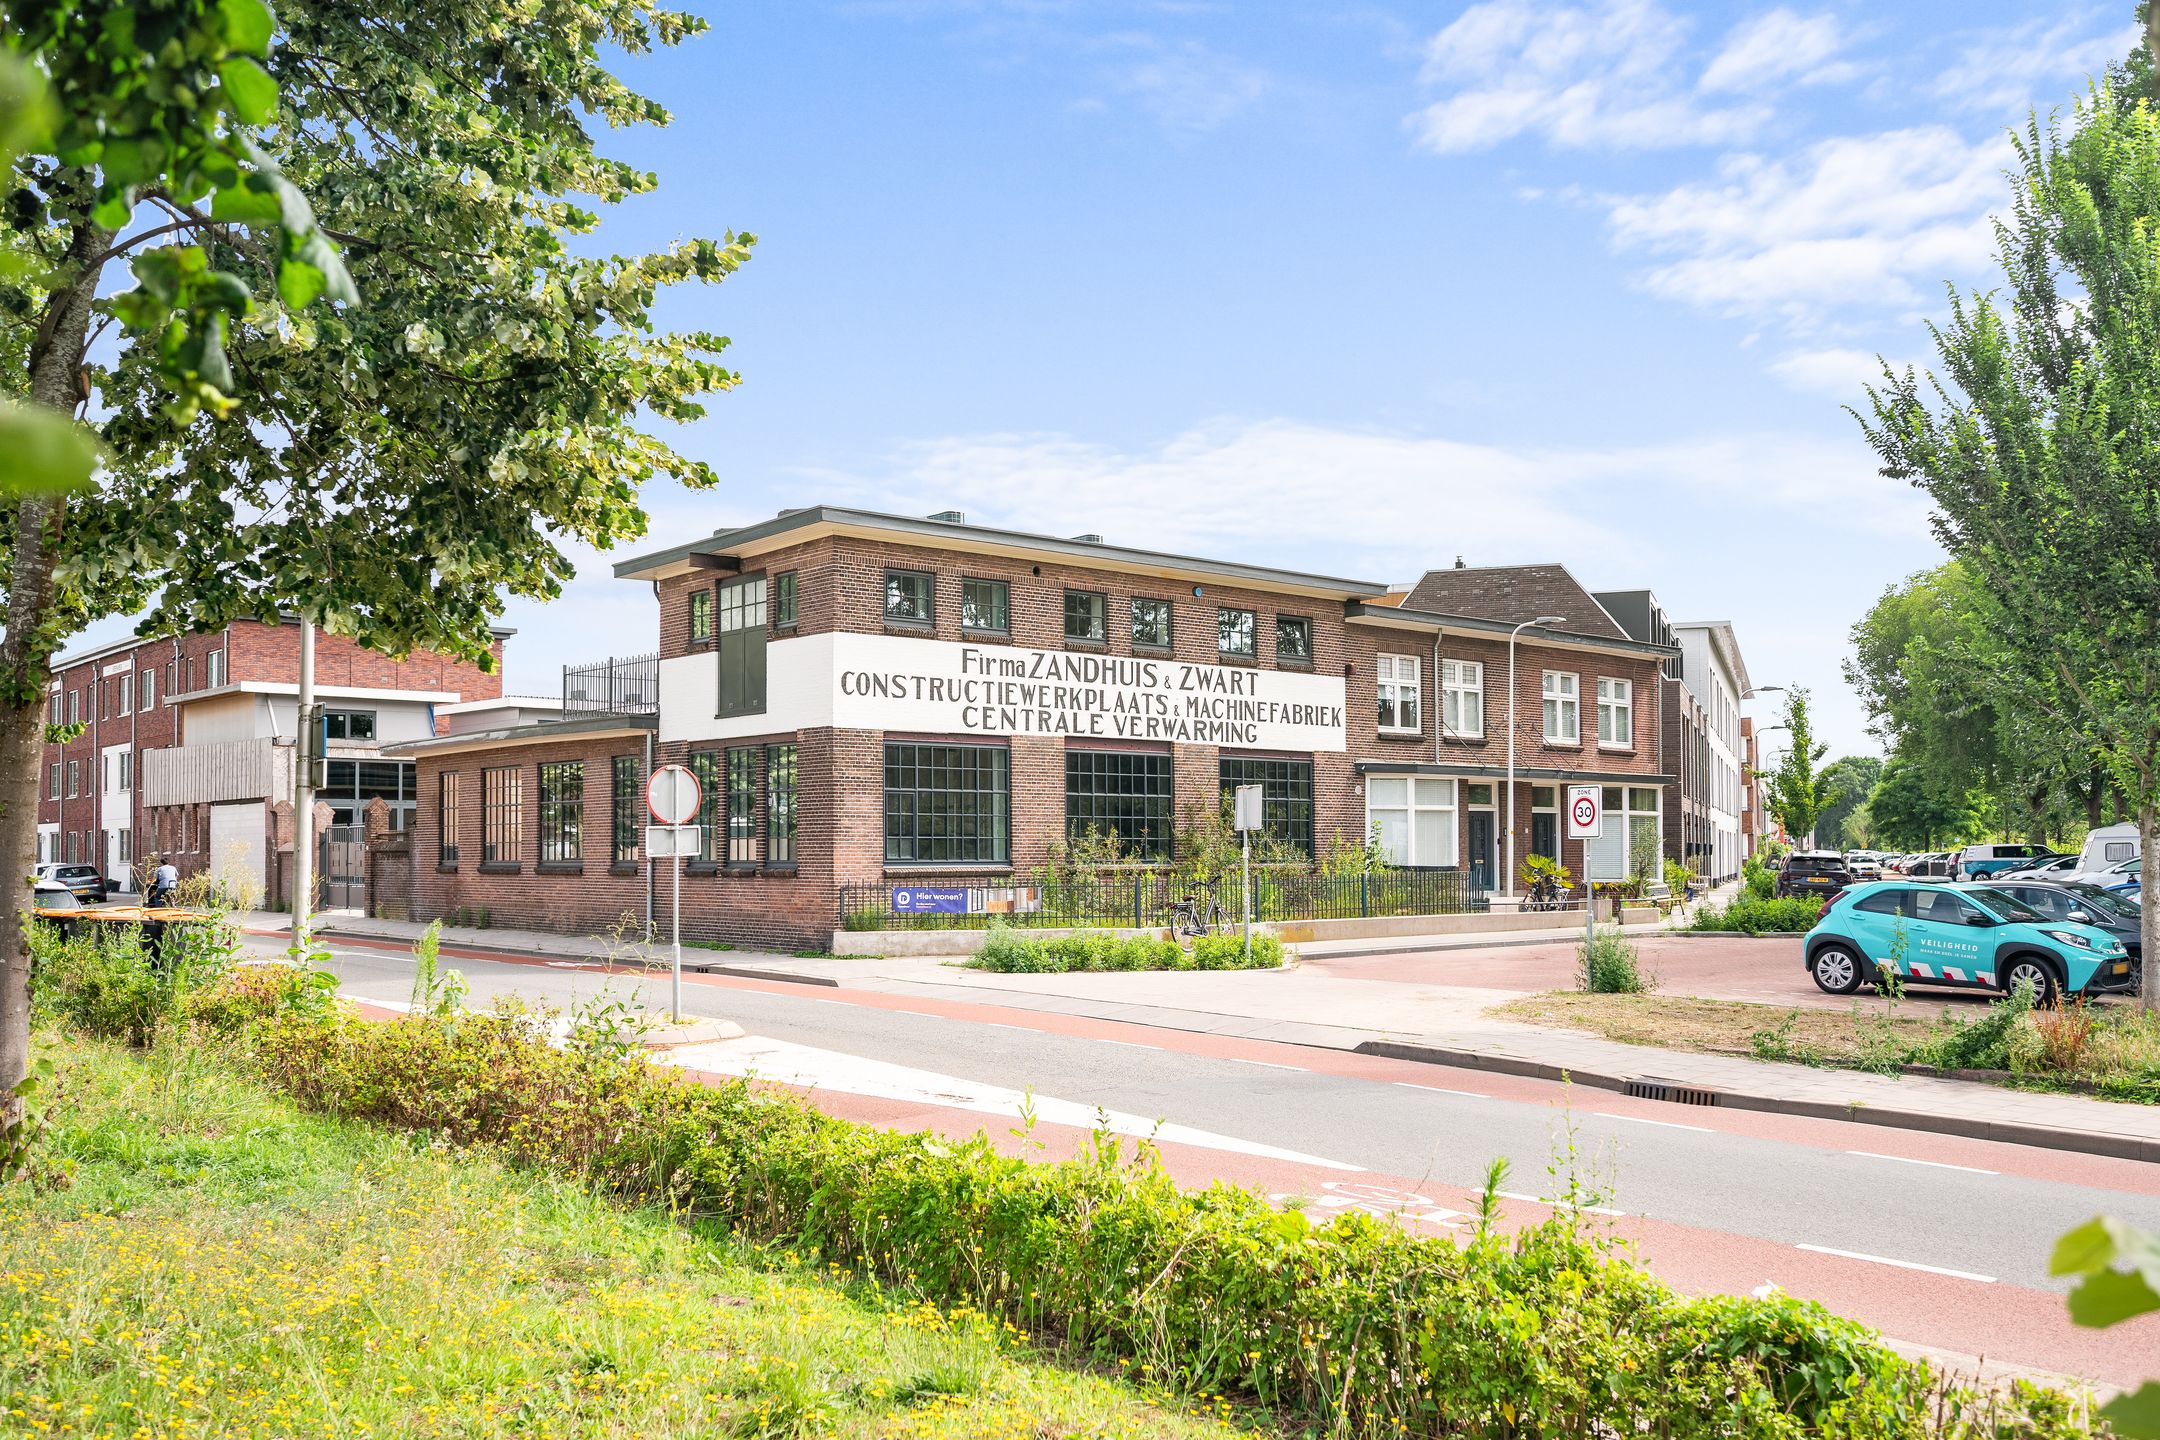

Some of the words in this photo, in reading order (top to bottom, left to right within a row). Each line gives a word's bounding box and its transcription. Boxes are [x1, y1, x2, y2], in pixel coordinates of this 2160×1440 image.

[962, 648, 1025, 678] Firma
[1028, 652, 1158, 688] ZANDHUIS
[1163, 675, 1173, 690] &
[1178, 665, 1259, 696] ZWART
[840, 671, 1168, 716] CONSTRUCTIEWERKPLAATS
[1173, 704, 1181, 717] &
[1186, 696, 1342, 728] MACHINEFABRIEK
[962, 706, 1104, 735] CENTRALE
[1113, 714, 1258, 743] VERWARMING
[1577, 806, 1592, 818] 30
[916, 892, 932, 900] Hier
[933, 893, 963, 901] wonen?
[1920, 939, 1978, 952] VEILIGHEID
